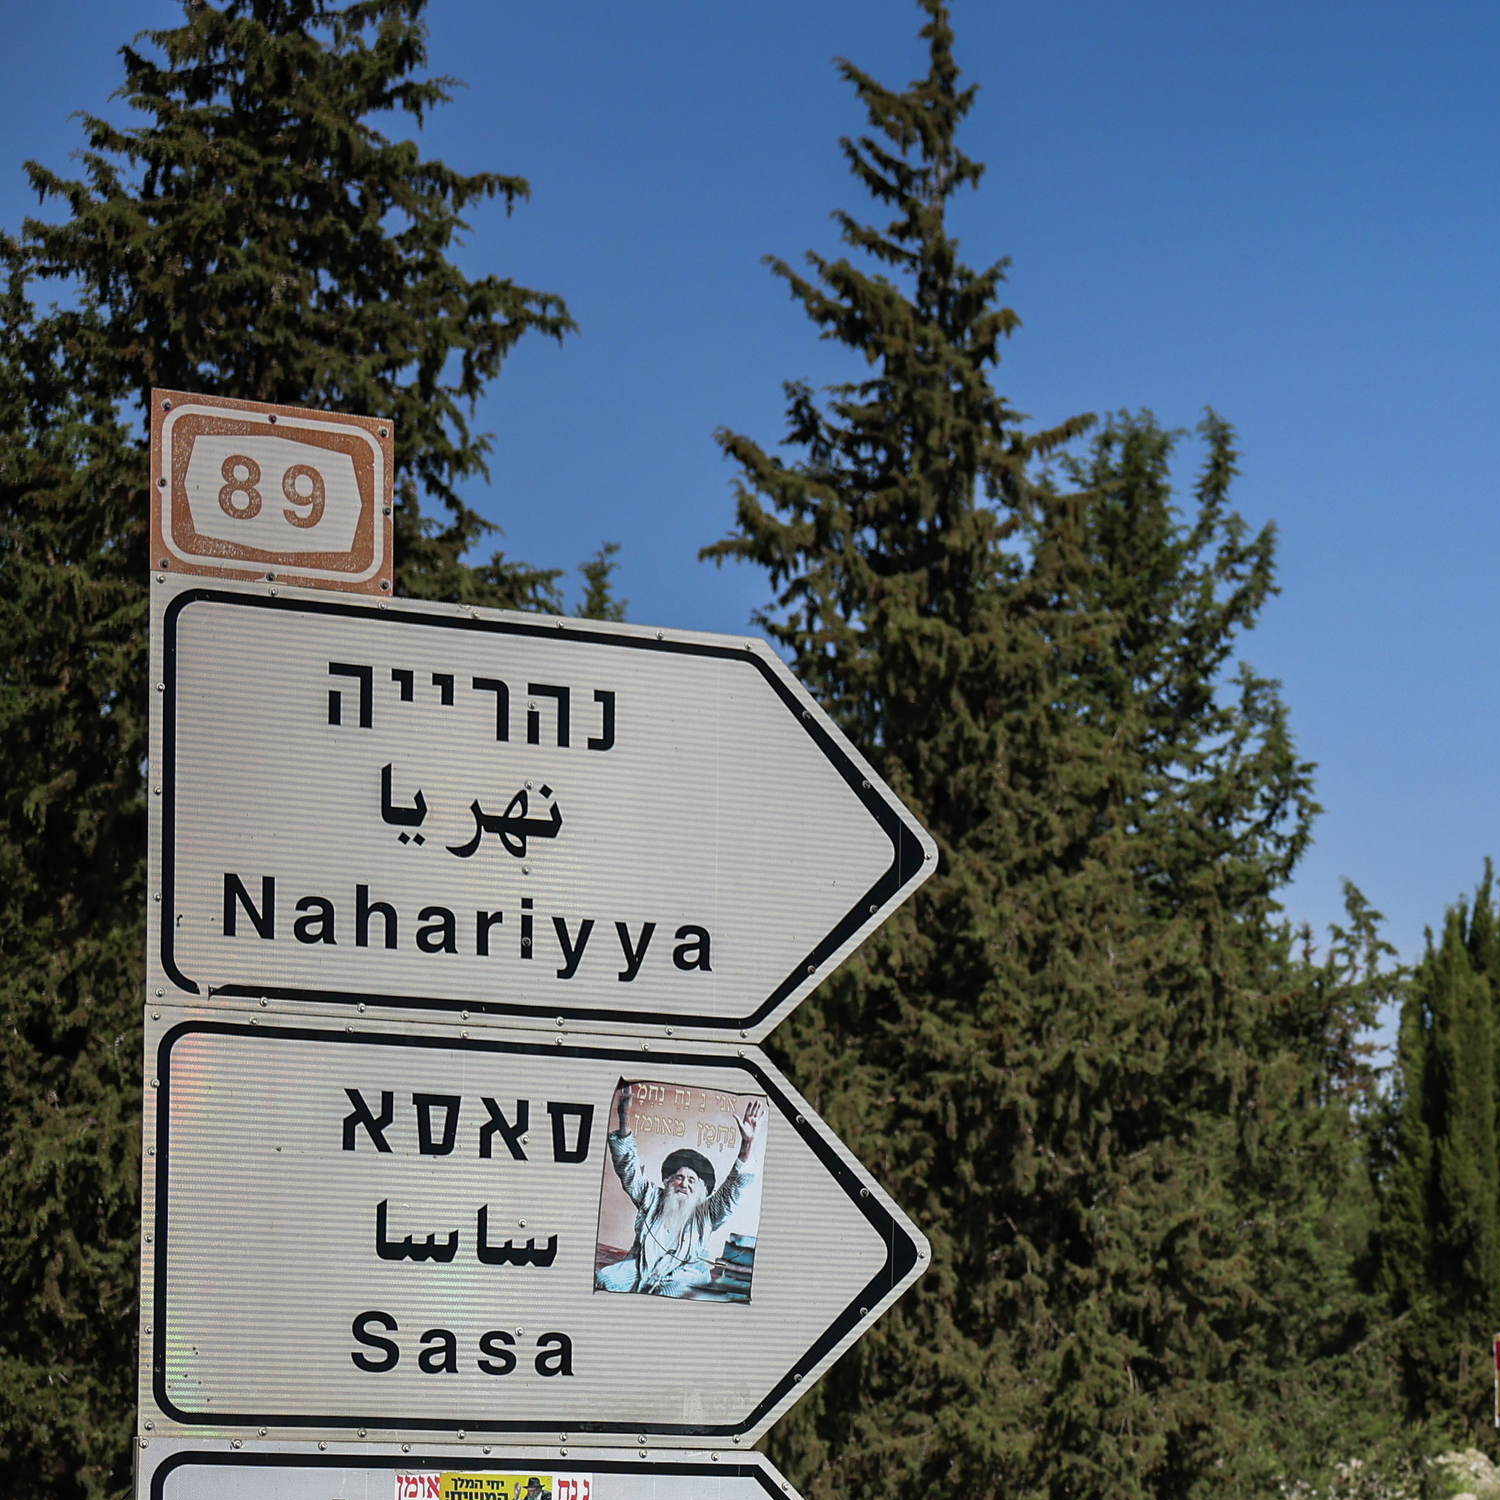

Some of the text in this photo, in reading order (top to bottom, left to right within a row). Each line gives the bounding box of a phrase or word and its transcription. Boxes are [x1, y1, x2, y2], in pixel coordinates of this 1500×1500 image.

[217, 453, 326, 529] 89
[326, 660, 617, 752] נהרייה
[379, 763, 564, 858] نهريا
[221, 872, 713, 983] Nahariyya
[341, 1087, 594, 1163] סאסא
[374, 1198, 559, 1268] ساسا
[350, 1310, 575, 1377] Sasa
[451, 1477, 504, 1491] יחי המלך
